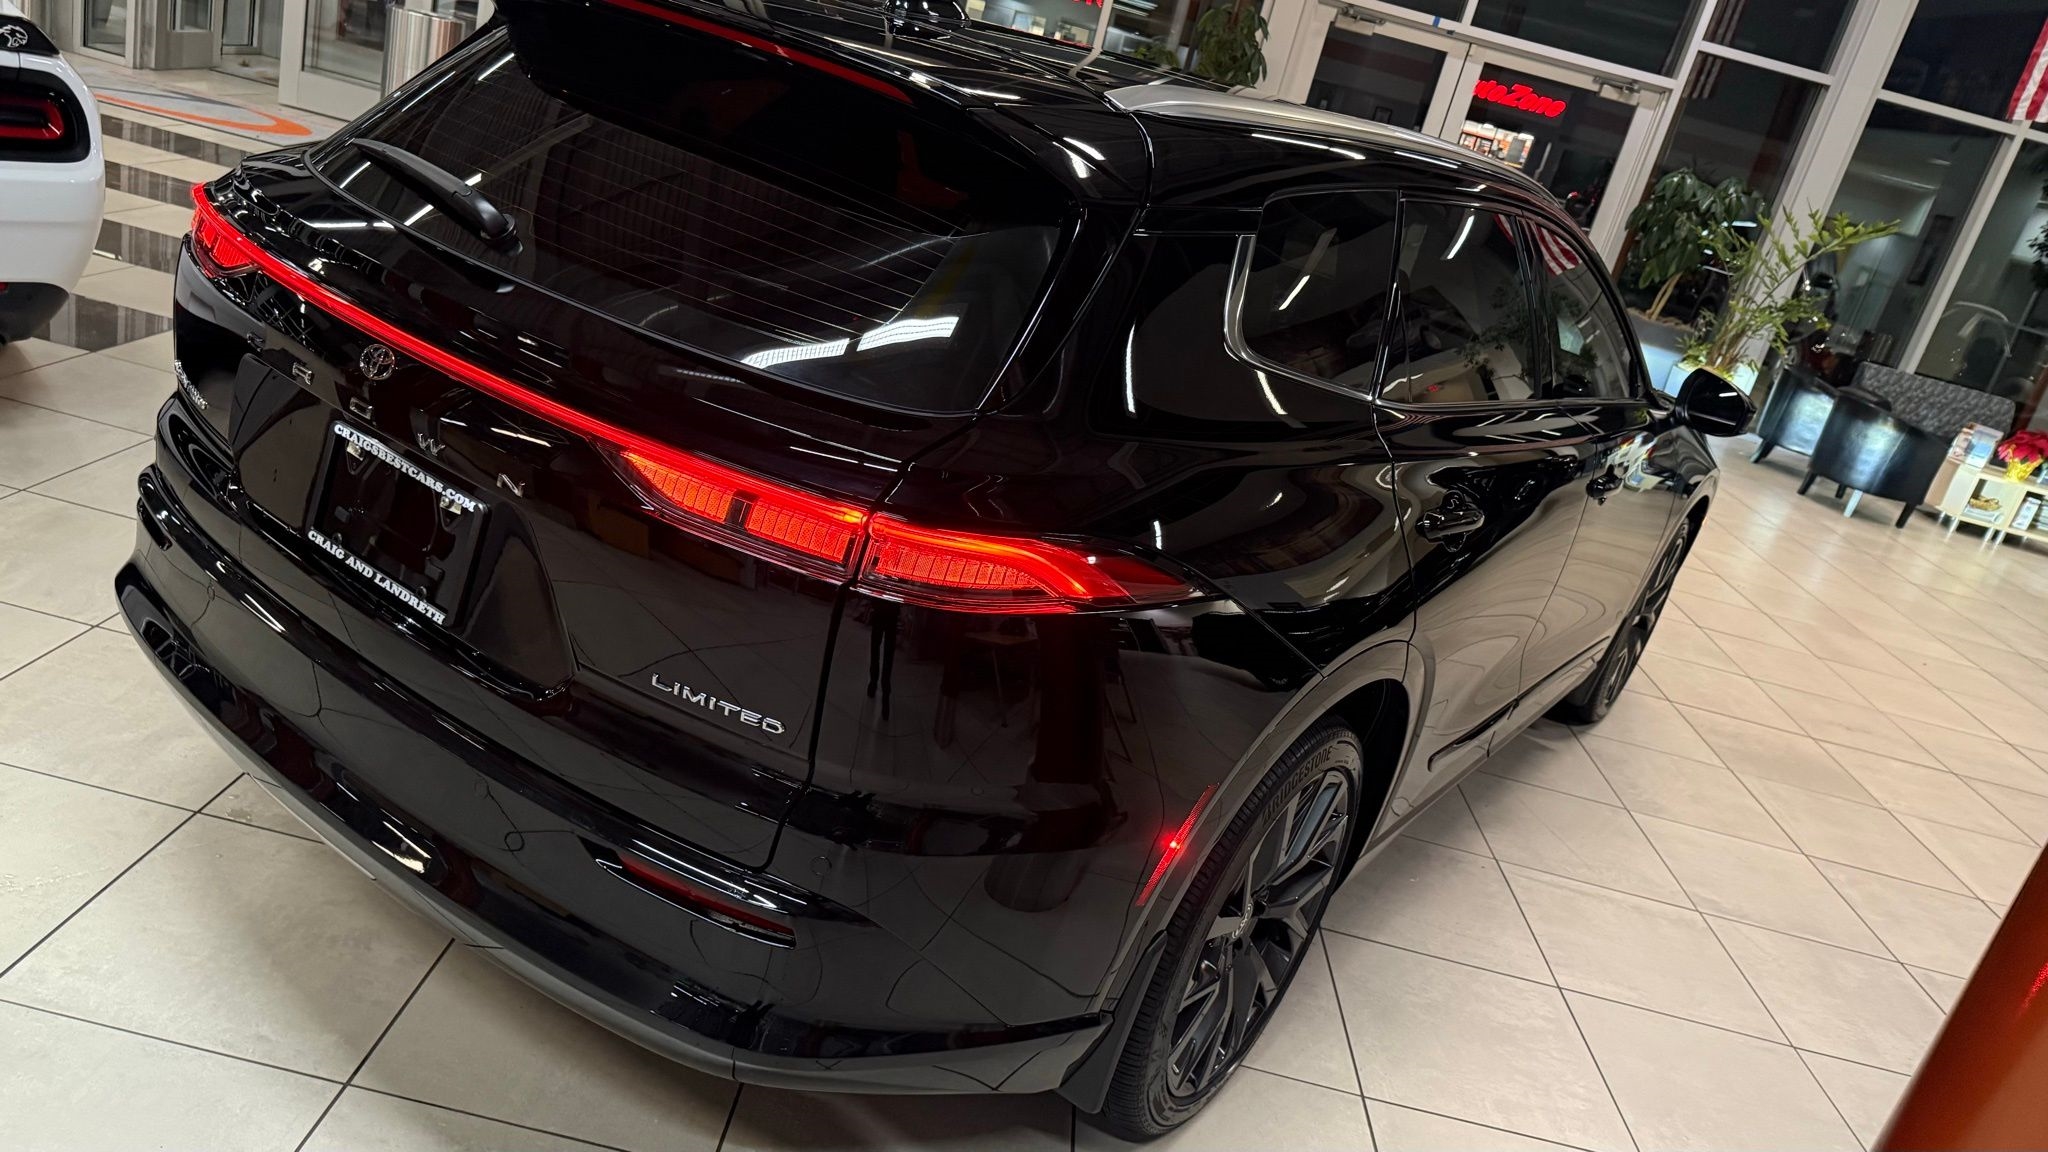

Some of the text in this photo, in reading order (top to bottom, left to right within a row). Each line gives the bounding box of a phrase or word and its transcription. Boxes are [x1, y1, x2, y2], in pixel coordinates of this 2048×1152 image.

[334, 424, 476, 512] CRAIGSBESTCARS.COM
[308, 530, 445, 625] CRAIG AND LANDRETH
[652, 673, 785, 734] LIMITED
[1263, 745, 1332, 826] BRIDGESTONE
